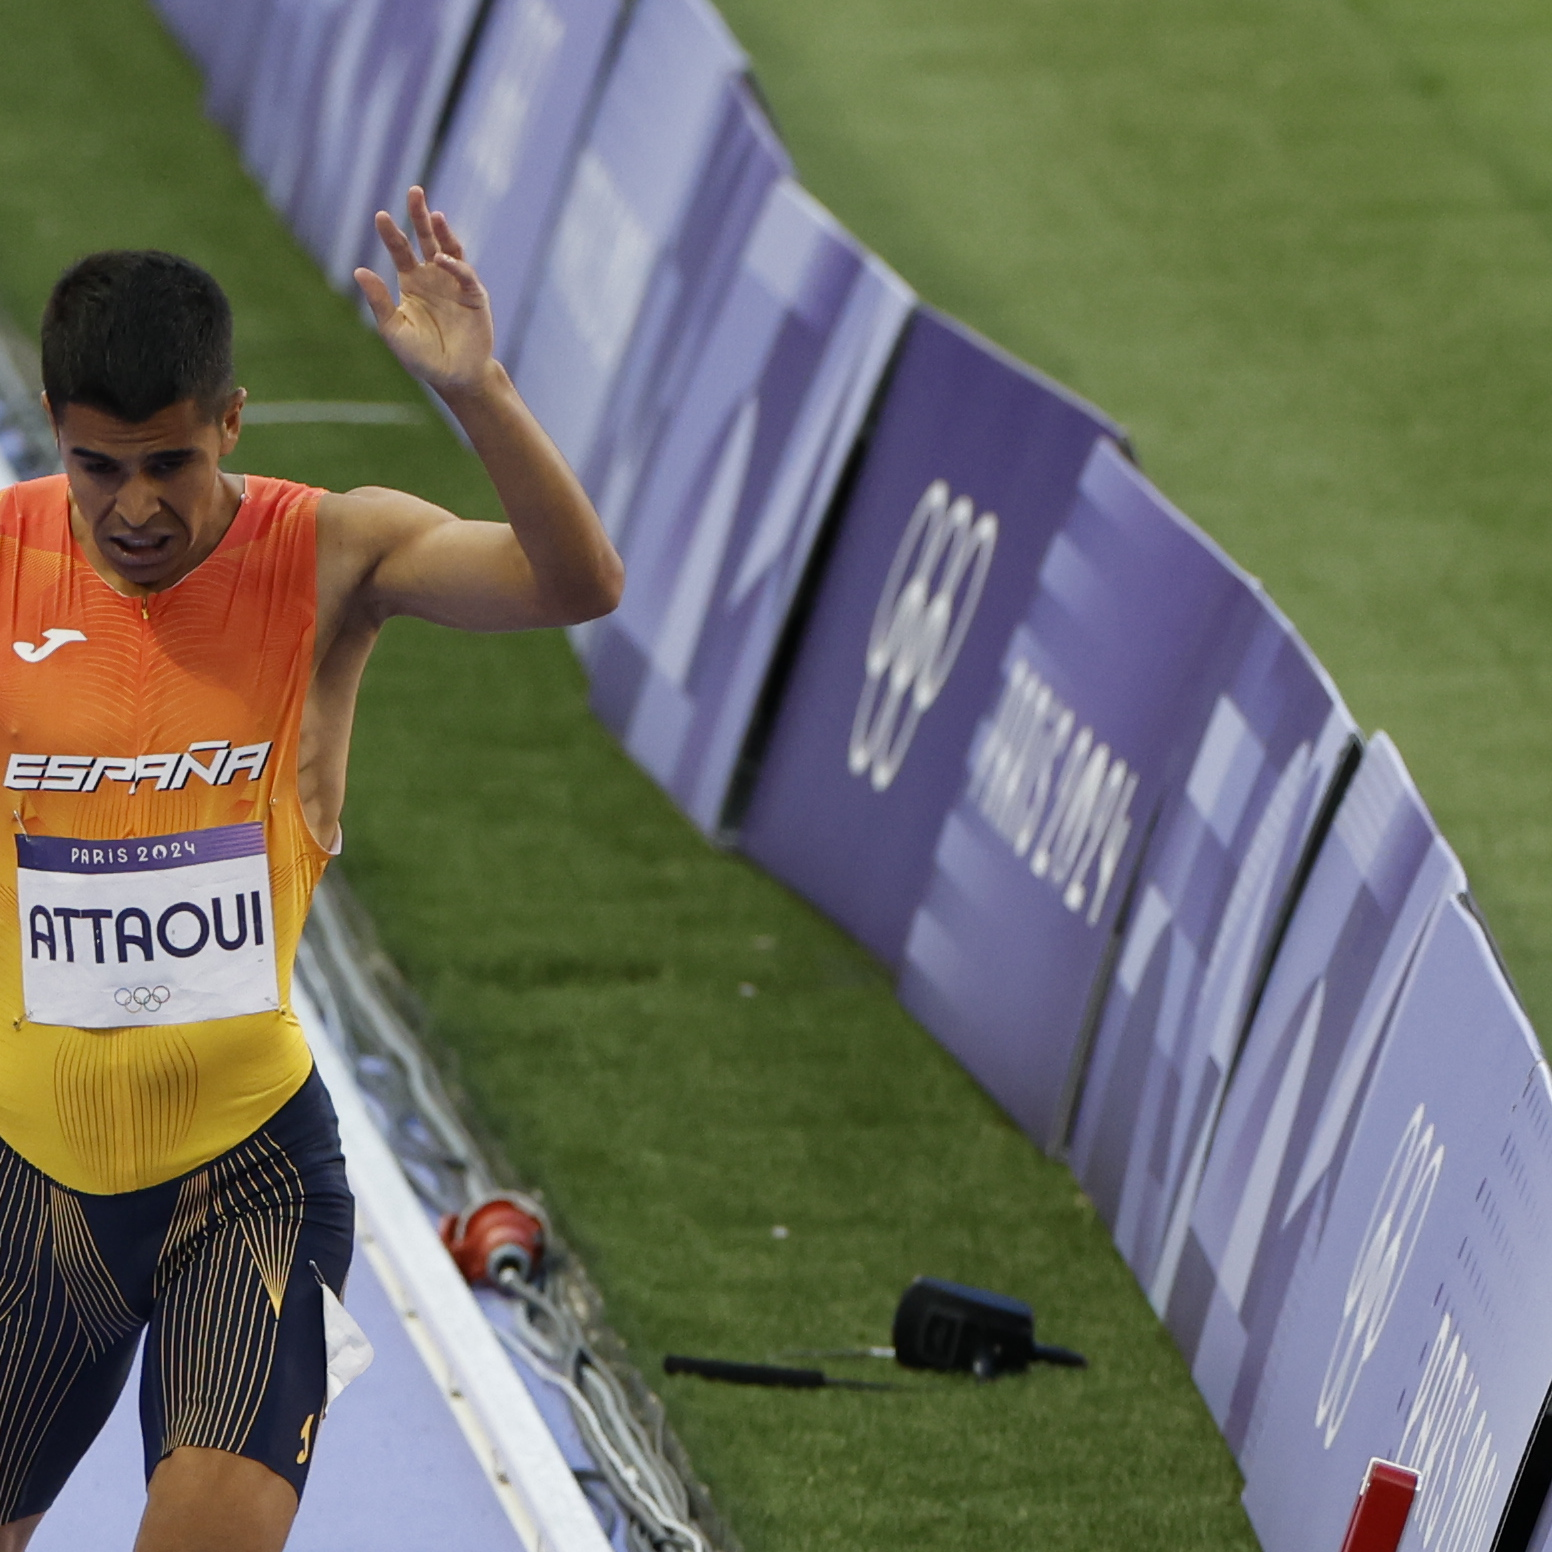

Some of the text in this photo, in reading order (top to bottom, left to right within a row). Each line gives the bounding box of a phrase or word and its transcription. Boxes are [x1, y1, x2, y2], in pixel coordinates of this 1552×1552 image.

[4, 740, 274, 796] ESPAÑA
[71, 841, 196, 865] PARIS 2024
[29, 890, 264, 964] ATTAOUI
